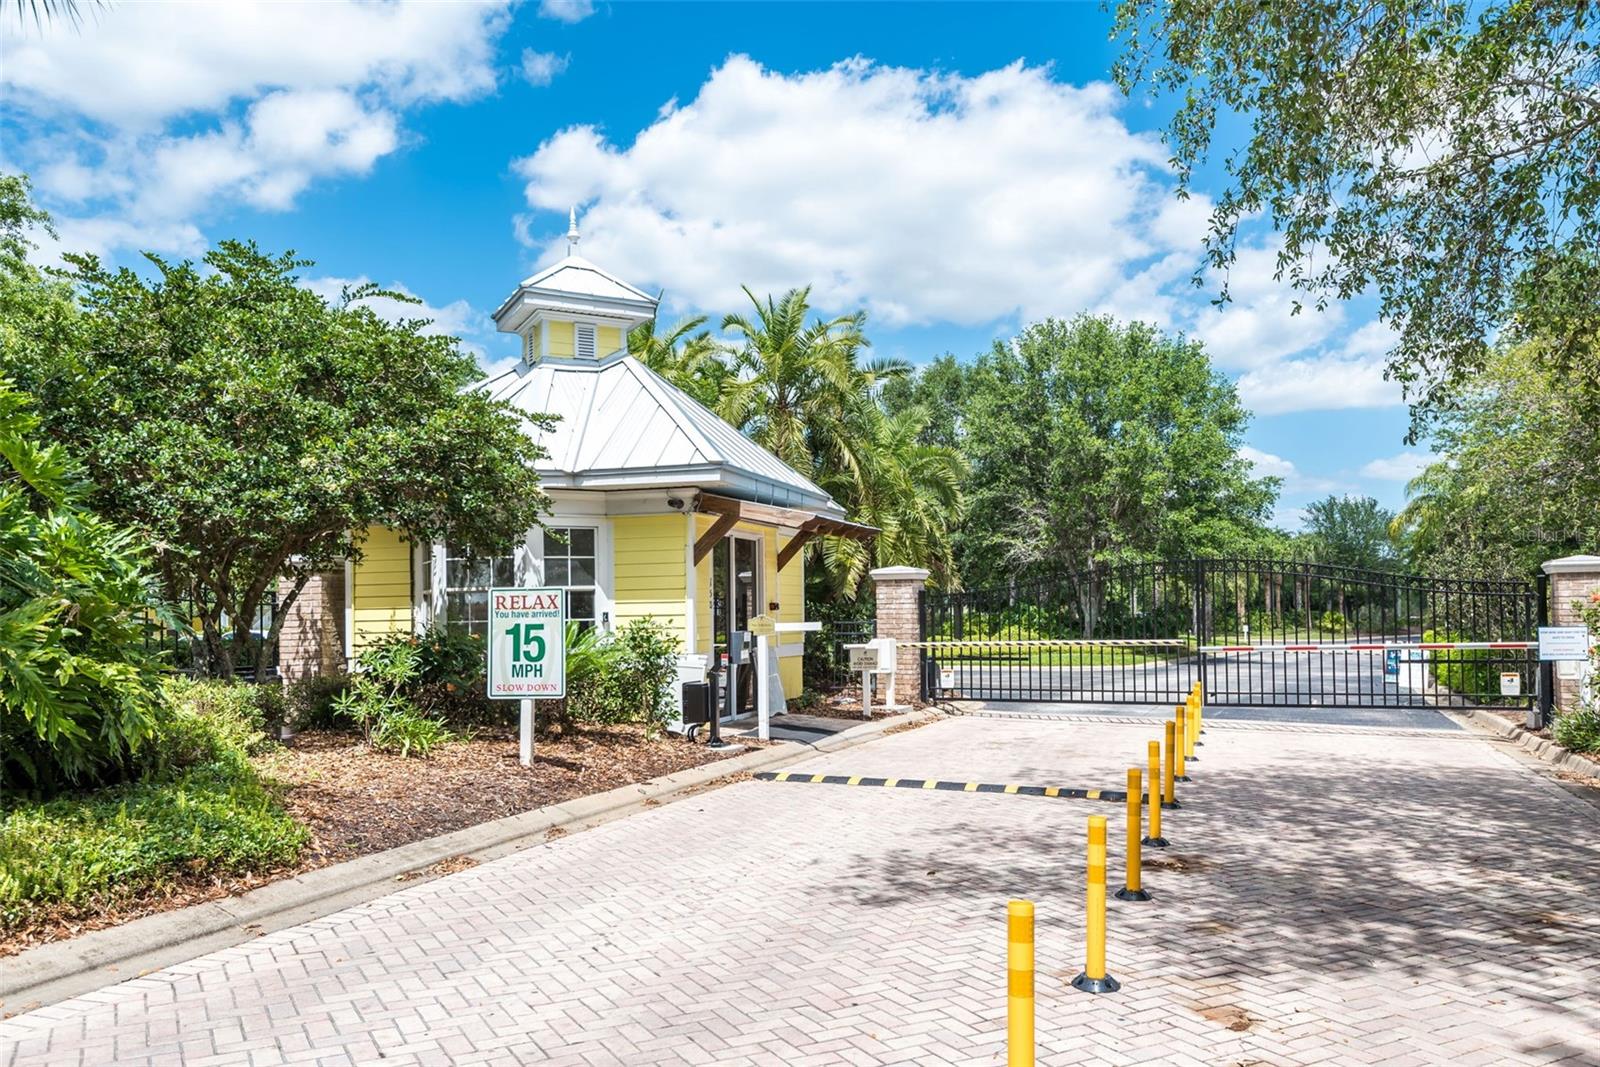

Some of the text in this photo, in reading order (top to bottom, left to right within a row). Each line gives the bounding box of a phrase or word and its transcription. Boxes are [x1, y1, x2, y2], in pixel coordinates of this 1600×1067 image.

[495, 594, 559, 610] RELAX
[495, 609, 560, 618] You have arrived!
[505, 623, 546, 662] 15
[511, 664, 543, 678] MPH
[496, 683, 558, 692] SLOW DOWN
